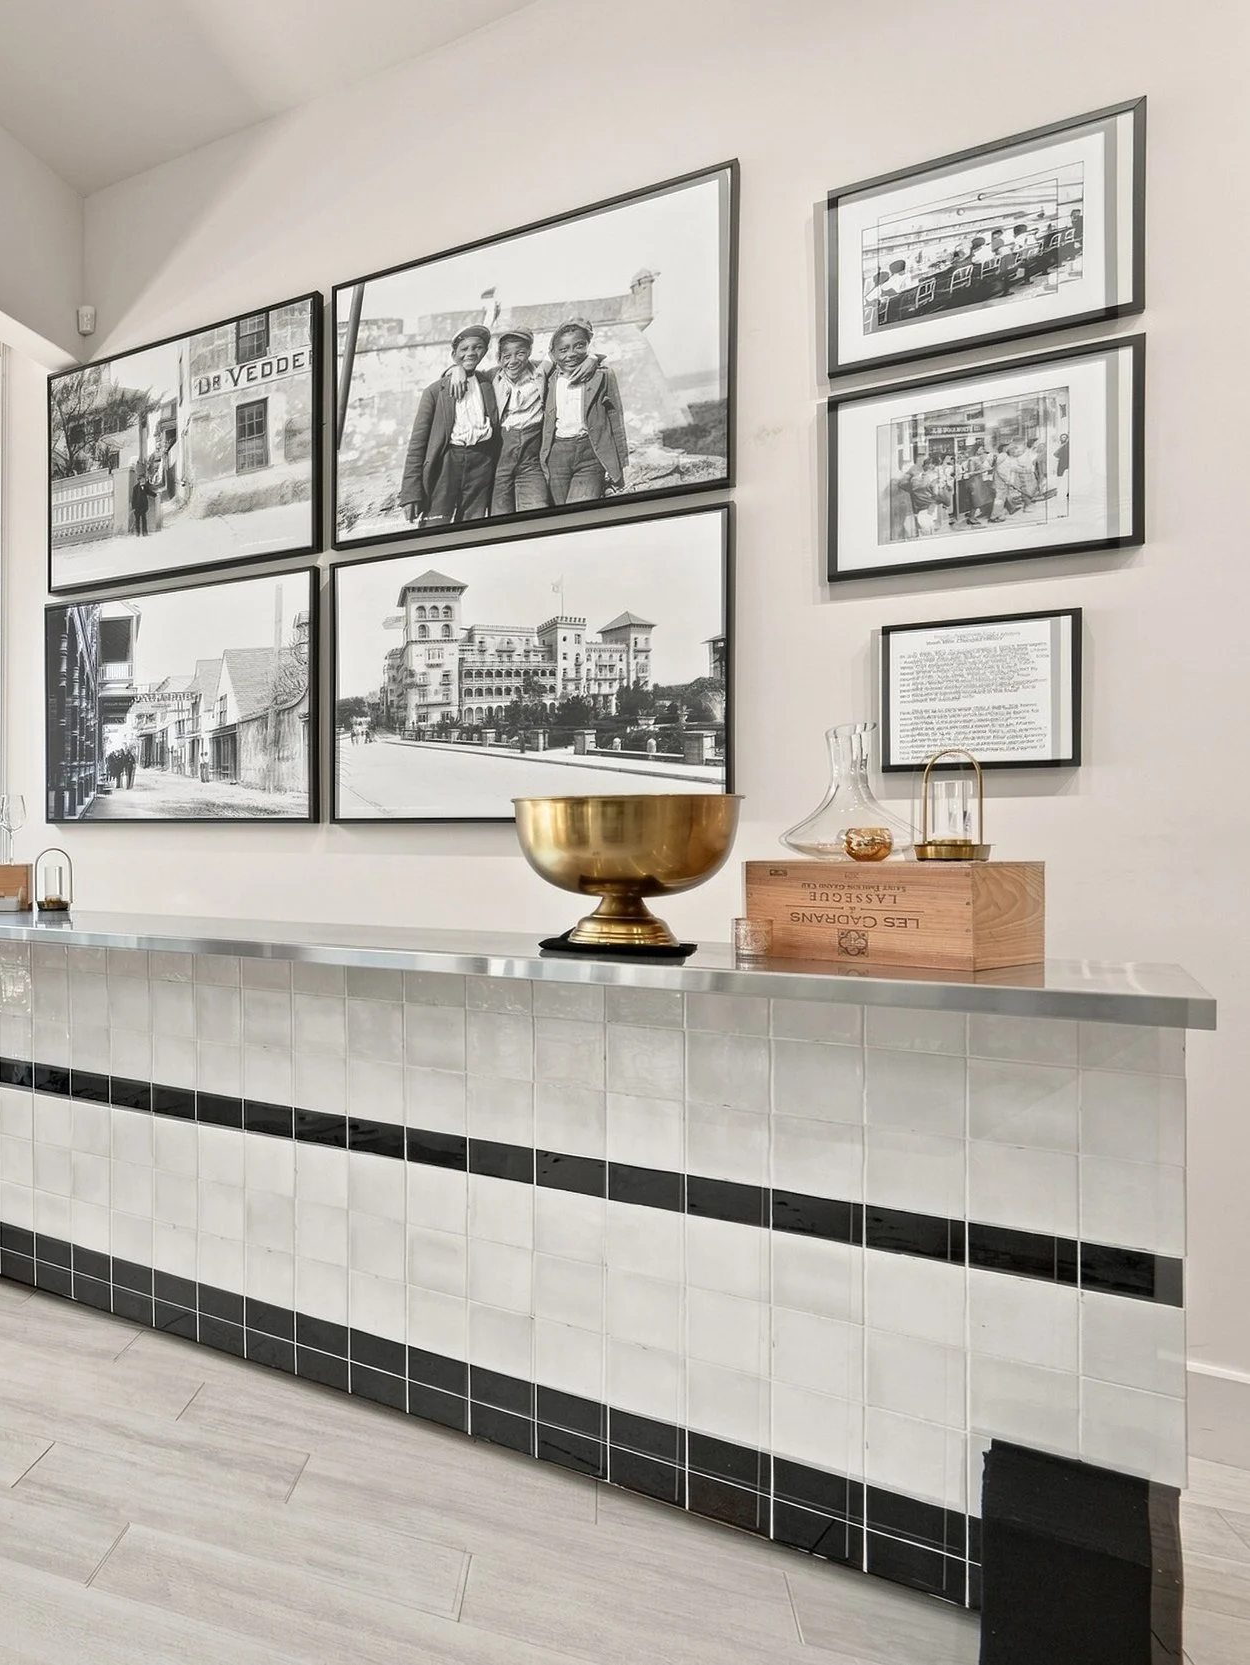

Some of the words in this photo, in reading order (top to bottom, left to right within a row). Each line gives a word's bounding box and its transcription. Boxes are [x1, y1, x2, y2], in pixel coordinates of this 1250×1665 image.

[801, 882, 817, 890] CRU
[818, 883, 845, 891] GRAND
[809, 891, 897, 905] LASSEGUE
[790, 912, 877, 929] CADRANS
[884, 917, 920, 929] LES
